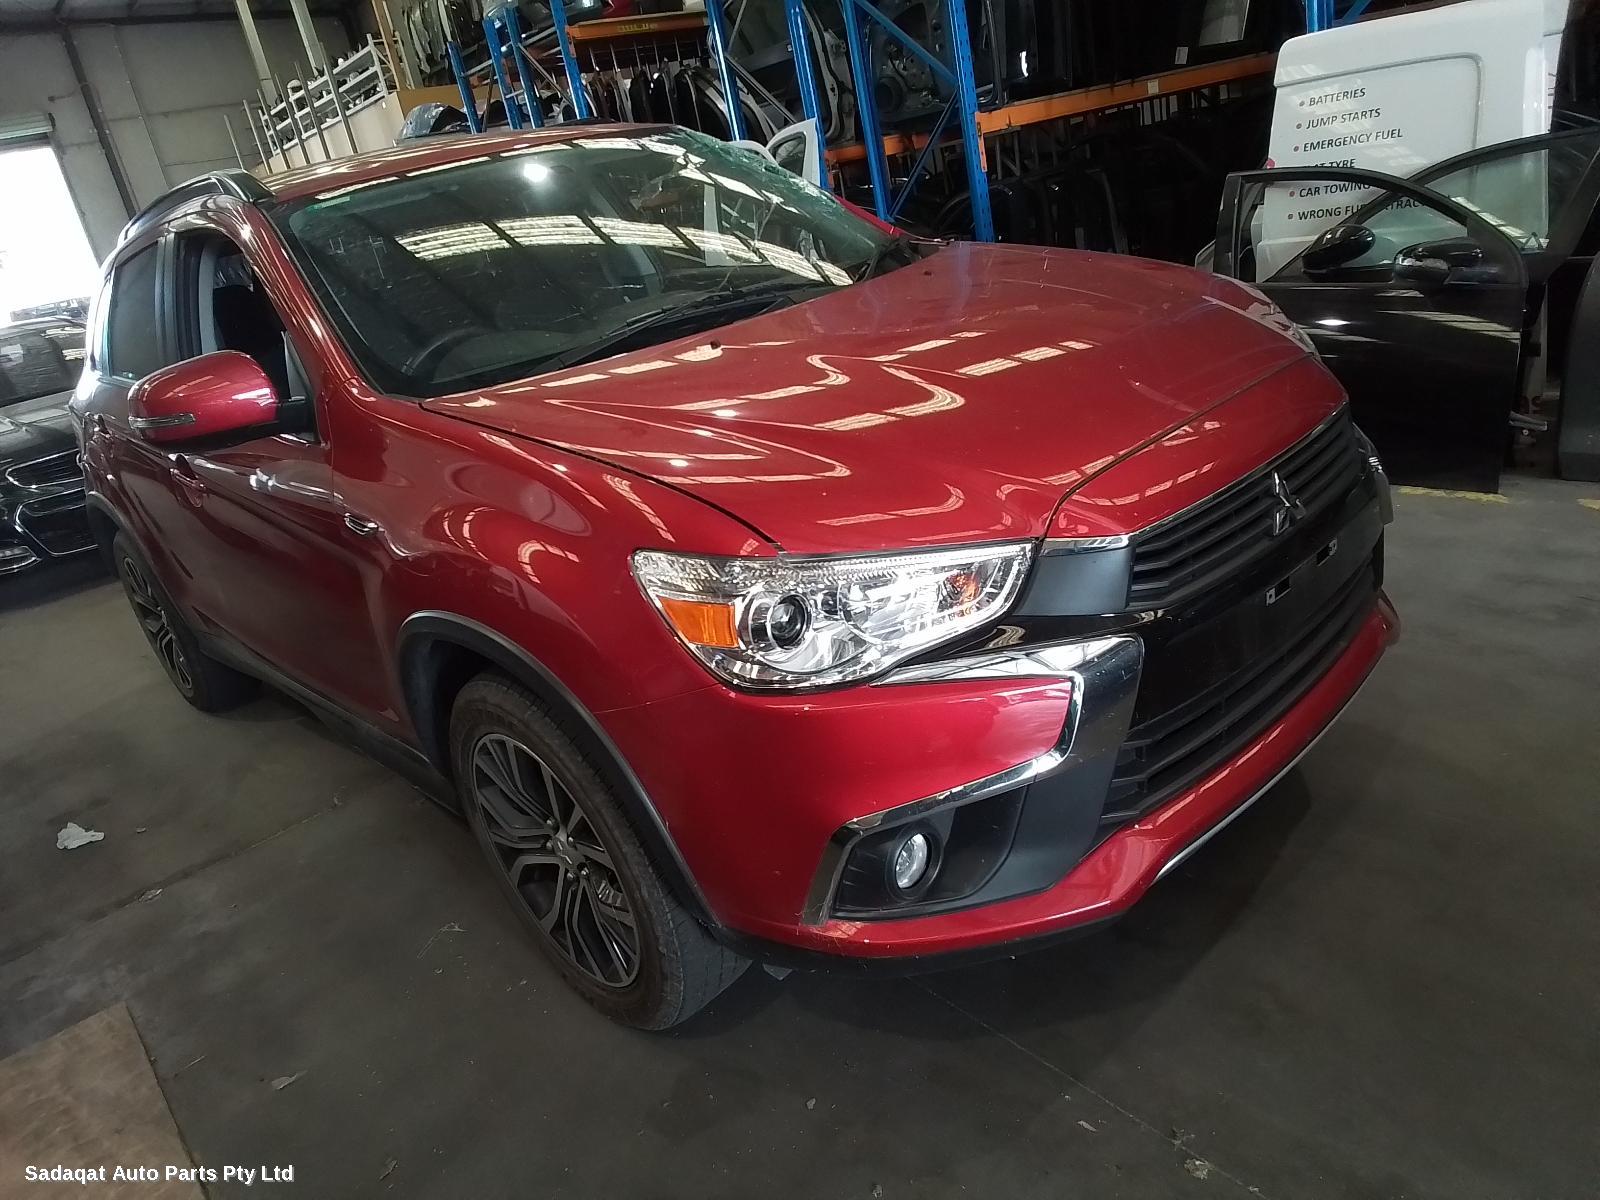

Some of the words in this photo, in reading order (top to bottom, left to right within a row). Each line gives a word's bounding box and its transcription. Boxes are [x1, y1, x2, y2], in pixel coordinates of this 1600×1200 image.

[1309, 88, 1366, 107] BATTERIES
[1306, 115, 1338, 130] JUMP
[1341, 108, 1381, 123] STARTS
[1303, 133, 1372, 152] EMERGENCY
[1375, 128, 1403, 141] FUEL
[1299, 186, 1320, 198] CAR
[1298, 206, 1341, 220] WRONG
